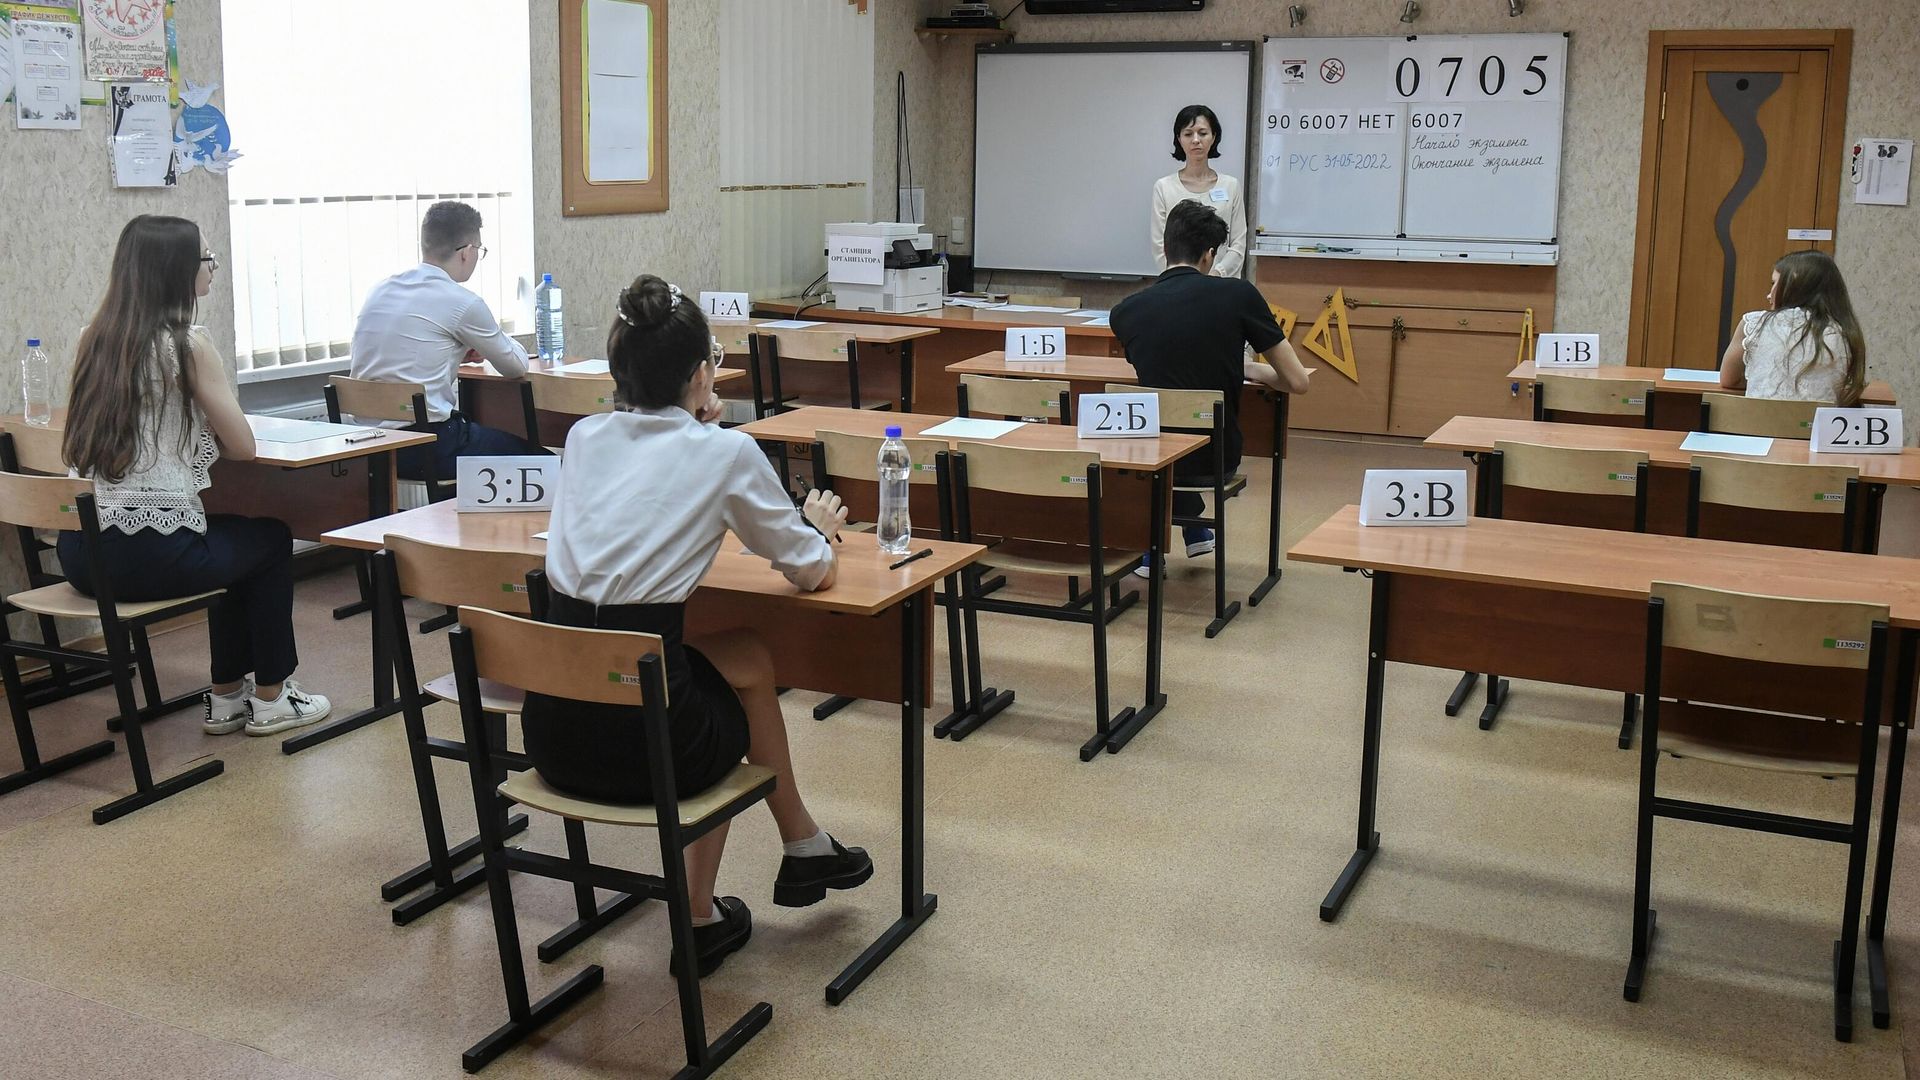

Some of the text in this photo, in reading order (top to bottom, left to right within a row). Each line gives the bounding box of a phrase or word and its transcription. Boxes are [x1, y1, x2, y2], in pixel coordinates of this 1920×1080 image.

[133, 94, 167, 103] ГРАМОТА
[1267, 112, 1396, 130] 90 6007 НЕТ
[1411, 112, 1463, 129] 6007
[1411, 134, 1529, 156] Начало экзамена
[1289, 153, 1319, 172] РУС
[1411, 154, 1544, 174] Окончание экзамена
[831, 256, 881, 264] ОРГАНИЗАТОРА
[840, 247, 872, 255] СТАНЦИЯ
[710, 297, 743, 316] 1:А
[1019, 334, 1056, 356] 1:Б
[1553, 340, 1591, 362] 1:В
[1095, 402, 1147, 432] 2:Б
[1830, 416, 1890, 446] 2:В
[477, 467, 545, 504] 3:Б
[1385, 480, 1455, 518] 3:В
[1836, 641, 1865, 649] 1135292
